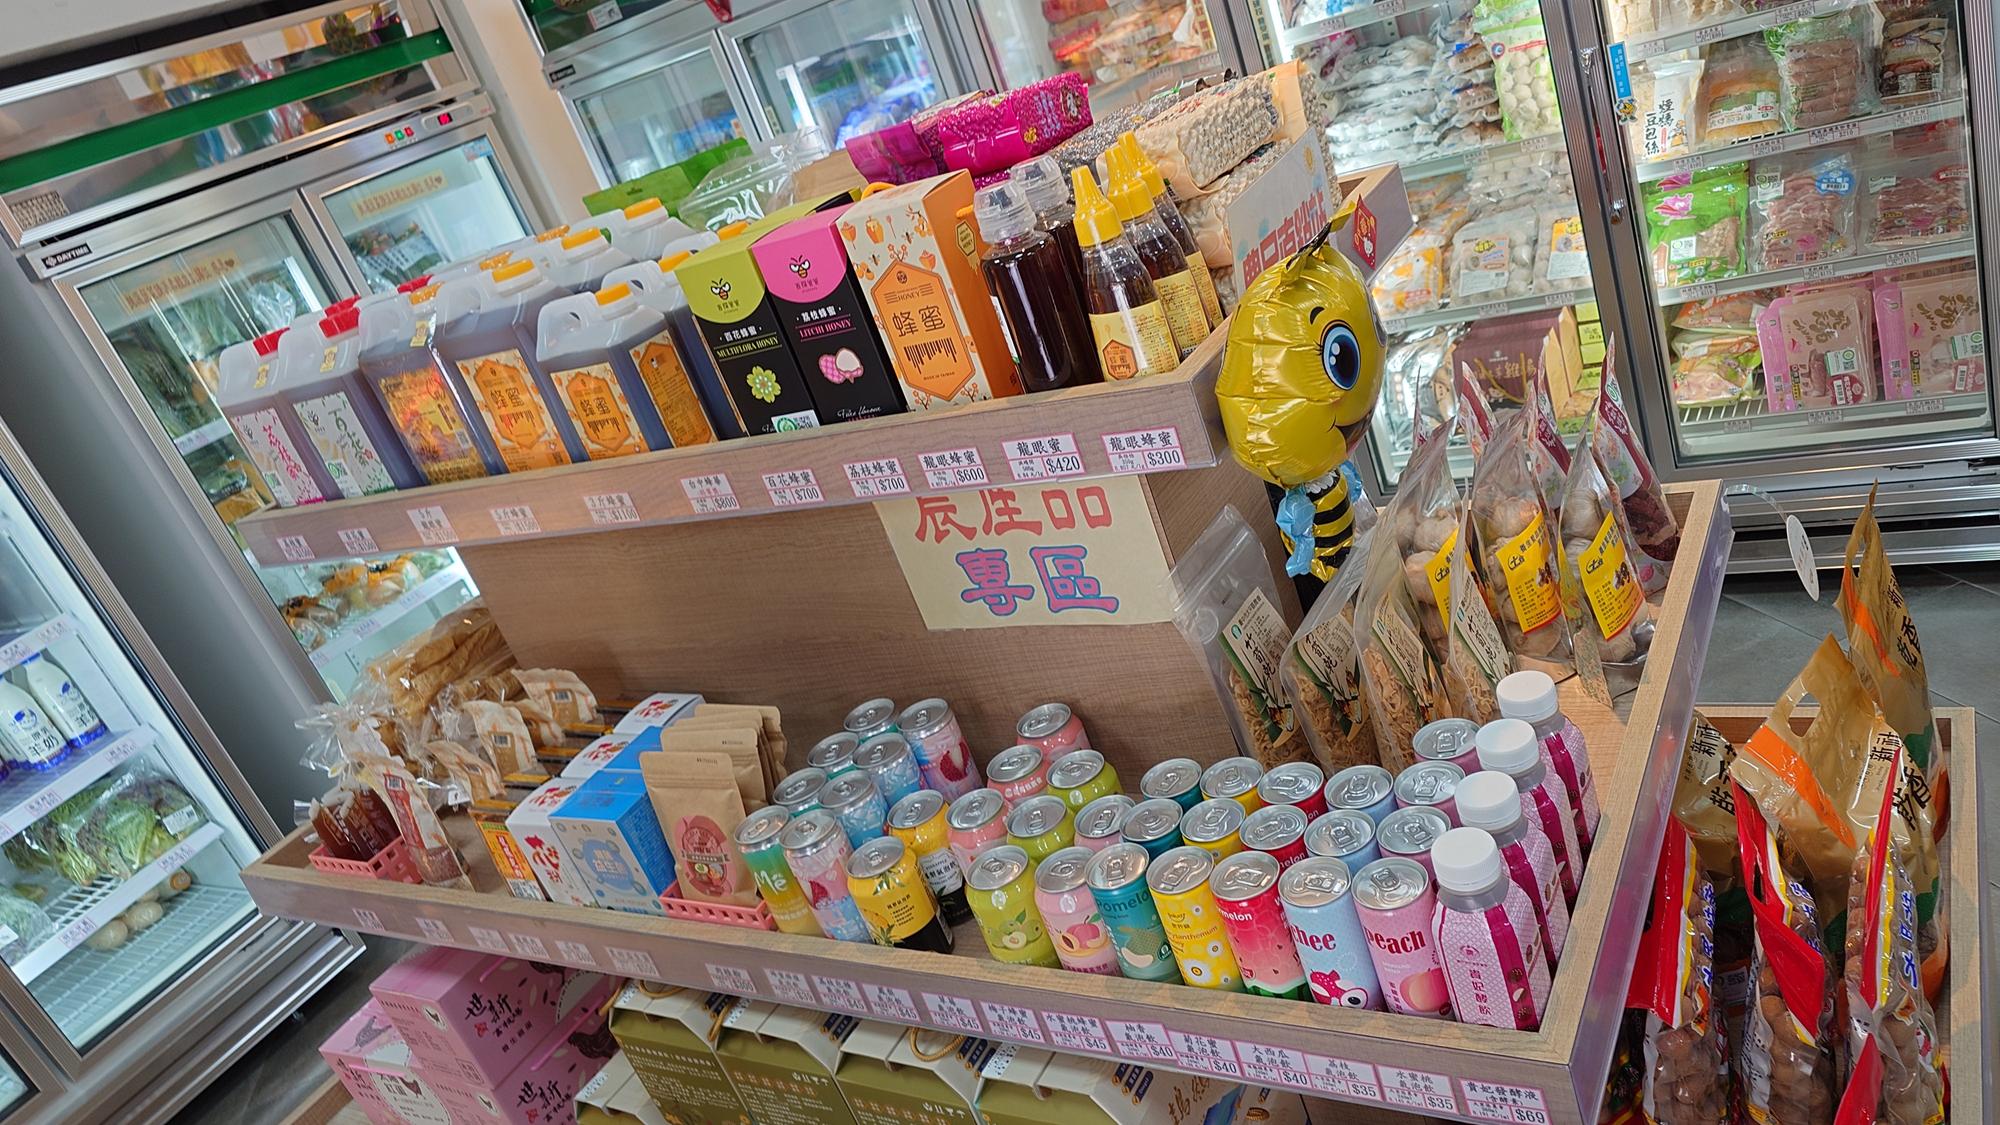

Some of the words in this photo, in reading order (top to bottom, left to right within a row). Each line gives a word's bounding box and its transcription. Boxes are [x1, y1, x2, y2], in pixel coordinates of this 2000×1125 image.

[56, 246, 90, 263] DAYTIME
[898, 290, 921, 302] HONEY
[800, 305, 837, 322] 荔枝蜂蜜
[800, 326, 825, 339] LITCHI
[825, 319, 852, 333] HONEY
[892, 305, 946, 338] 蜂蜜
[723, 326, 758, 342] 百花蜂蜜
[756, 337, 780, 350] HONEY
[490, 387, 524, 410] 蜂蜜
[580, 397, 612, 417] 蜂蜜
[1016, 437, 1062, 457] 龍眼蜜
[1109, 431, 1174, 452] 龍眼蜂蜜
[922, 449, 978, 470] 龍眼蜂蜜
[1045, 455, 1081, 474] $420
[1149, 450, 1181, 467] $300
[848, 460, 901, 479] 荔枝蜂蜜
[956, 466, 986, 484] $600
[765, 472, 814, 489] 百花蜂蜜
[879, 477, 906, 492] $700
[794, 487, 820, 502] $700
[714, 496, 738, 509] $800
[955, 545, 1120, 617] 專區
[900, 1008, 918, 1021] $45
[997, 1013, 1027, 1026] 氣泡飲
[1046, 1012, 1098, 1029] 水蜜桃蜂蜜
[959, 1017, 979, 1030] $45
[1060, 1023, 1093, 1037] 氣泡飲
[1020, 1028, 1041, 1041] $45
[1125, 1032, 1159, 1044] 氣泡飲
[1183, 1034, 1218, 1049] 菊花蜜
[1085, 1037, 1107, 1050] $45
[1150, 1046, 1174, 1058] $40
[1186, 1044, 1223, 1059] 氣泡飲
[1251, 1044, 1290, 1060] 大西瓜
[1213, 1060, 1238, 1074] $40
[1254, 1054, 1294, 1070] 氣泡飲
[1328, 1059, 1350, 1071] 荔枝
[1282, 1071, 1309, 1086] $40
[1325, 1067, 1360, 1082] 氣泡飲
[1396, 1071, 1434, 1085] 水蜜桃
[1351, 1083, 1378, 1097] $35
[1399, 1080, 1436, 1094] 氣泡飲
[1466, 1081, 1539, 1101] 貴妃發酵液
[1427, 1096, 1455, 1111] $35
[1514, 1108, 1546, 1124] $69
